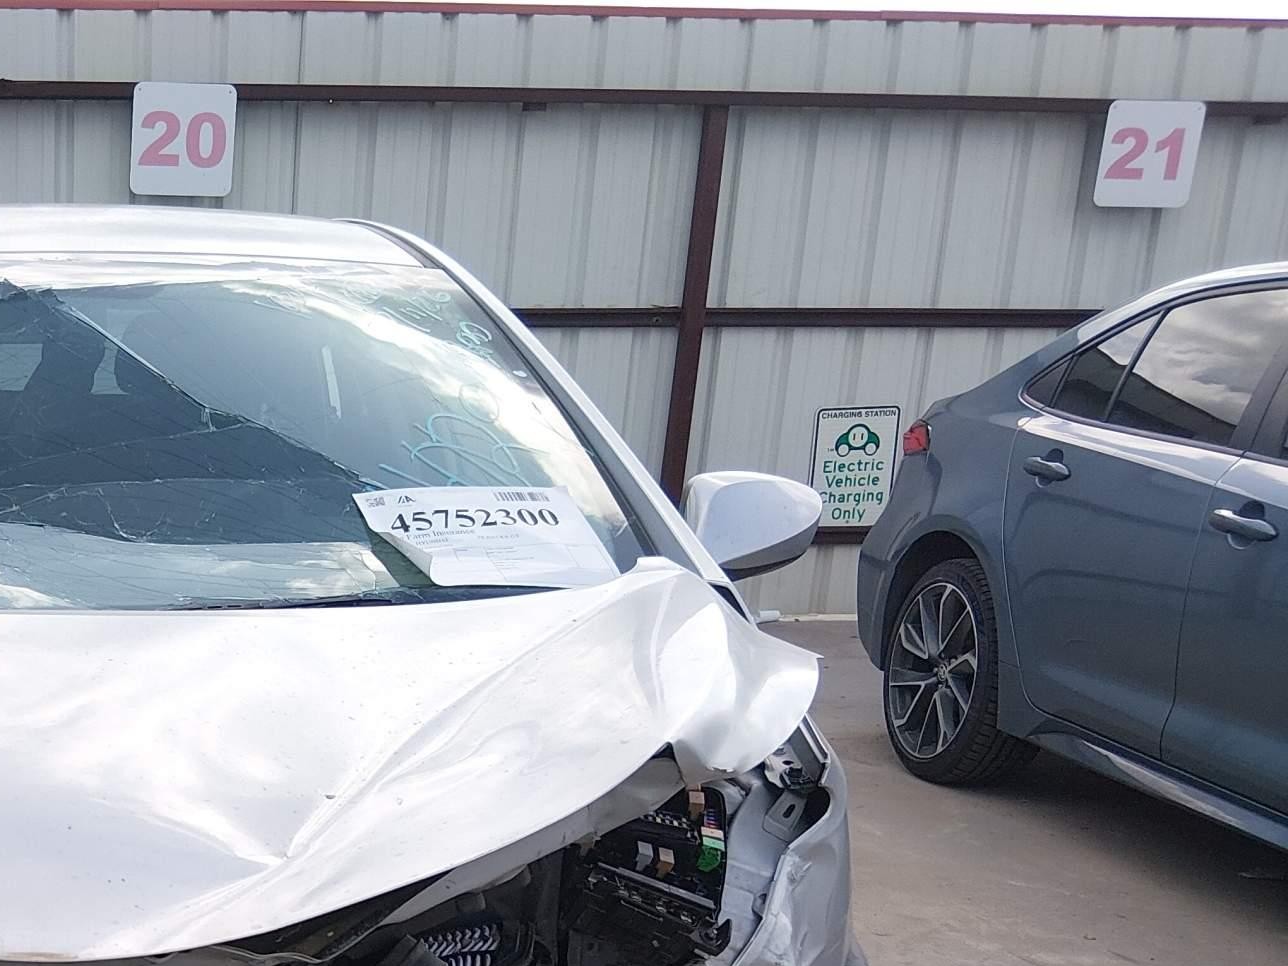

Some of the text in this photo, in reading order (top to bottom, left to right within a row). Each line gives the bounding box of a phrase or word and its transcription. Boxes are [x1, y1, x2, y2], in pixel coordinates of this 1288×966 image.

[137, 110, 227, 168] 20
[1103, 127, 1186, 181] 21
[821, 409, 897, 419] CHARGING STATION
[823, 459, 884, 473] Electric
[825, 475, 880, 488] Vehicle
[819, 490, 884, 505] Charging
[390, 508, 560, 533] 45752300
[832, 507, 865, 522] Only
